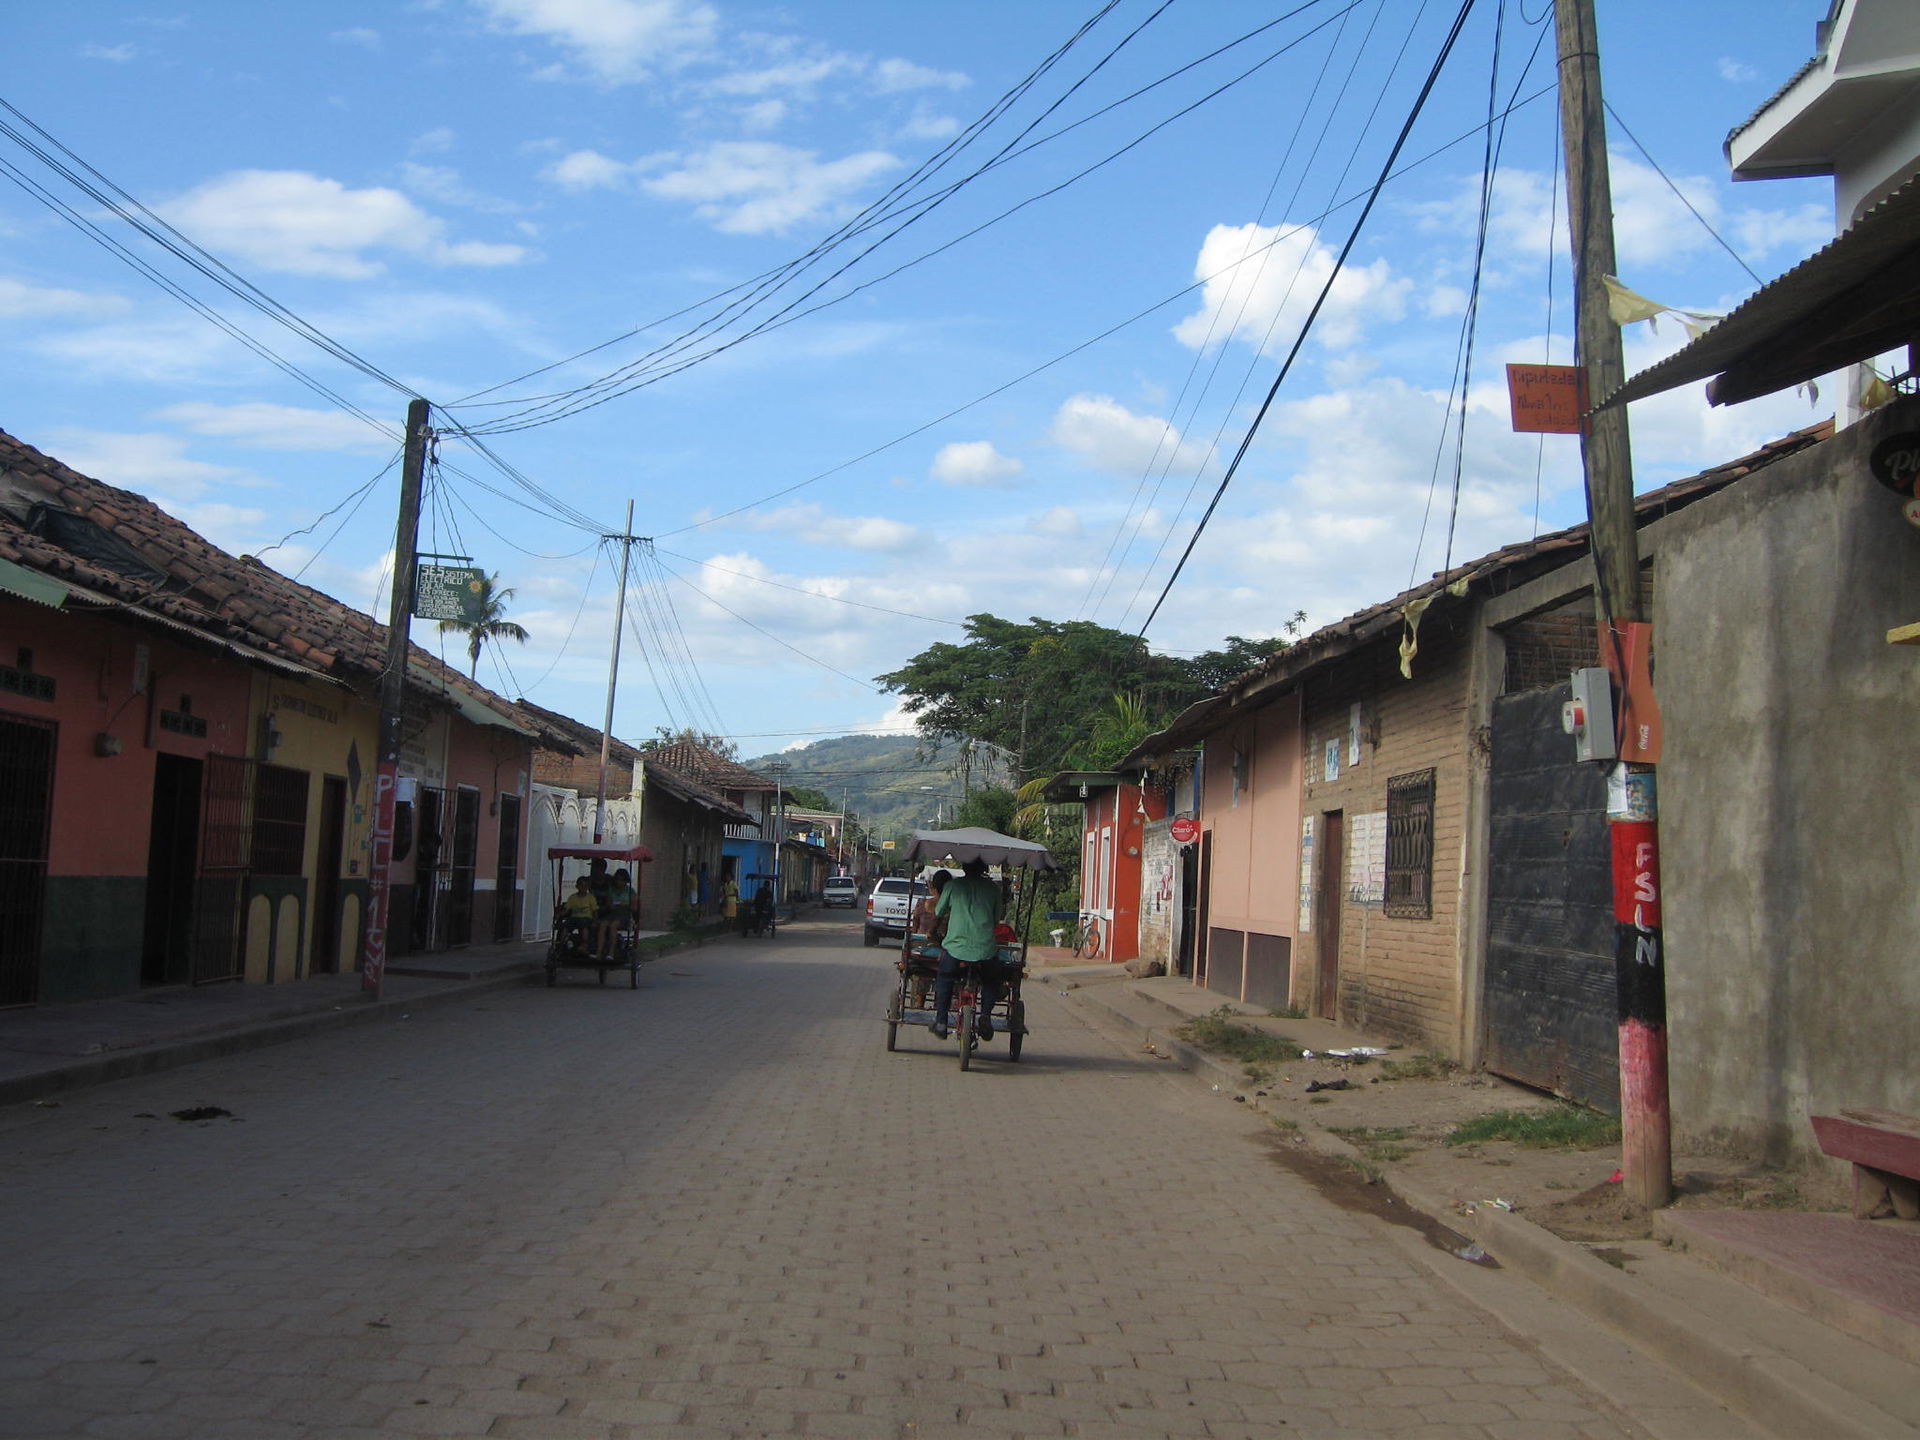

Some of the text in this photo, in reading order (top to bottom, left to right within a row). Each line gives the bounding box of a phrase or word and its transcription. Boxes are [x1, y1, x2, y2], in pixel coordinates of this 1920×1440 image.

[421, 566, 474, 579] SES SISTEMA
[420, 582, 444, 590] SOLAR
[1634, 842, 1656, 967] FSLN
[885, 907, 909, 915] TOYO
